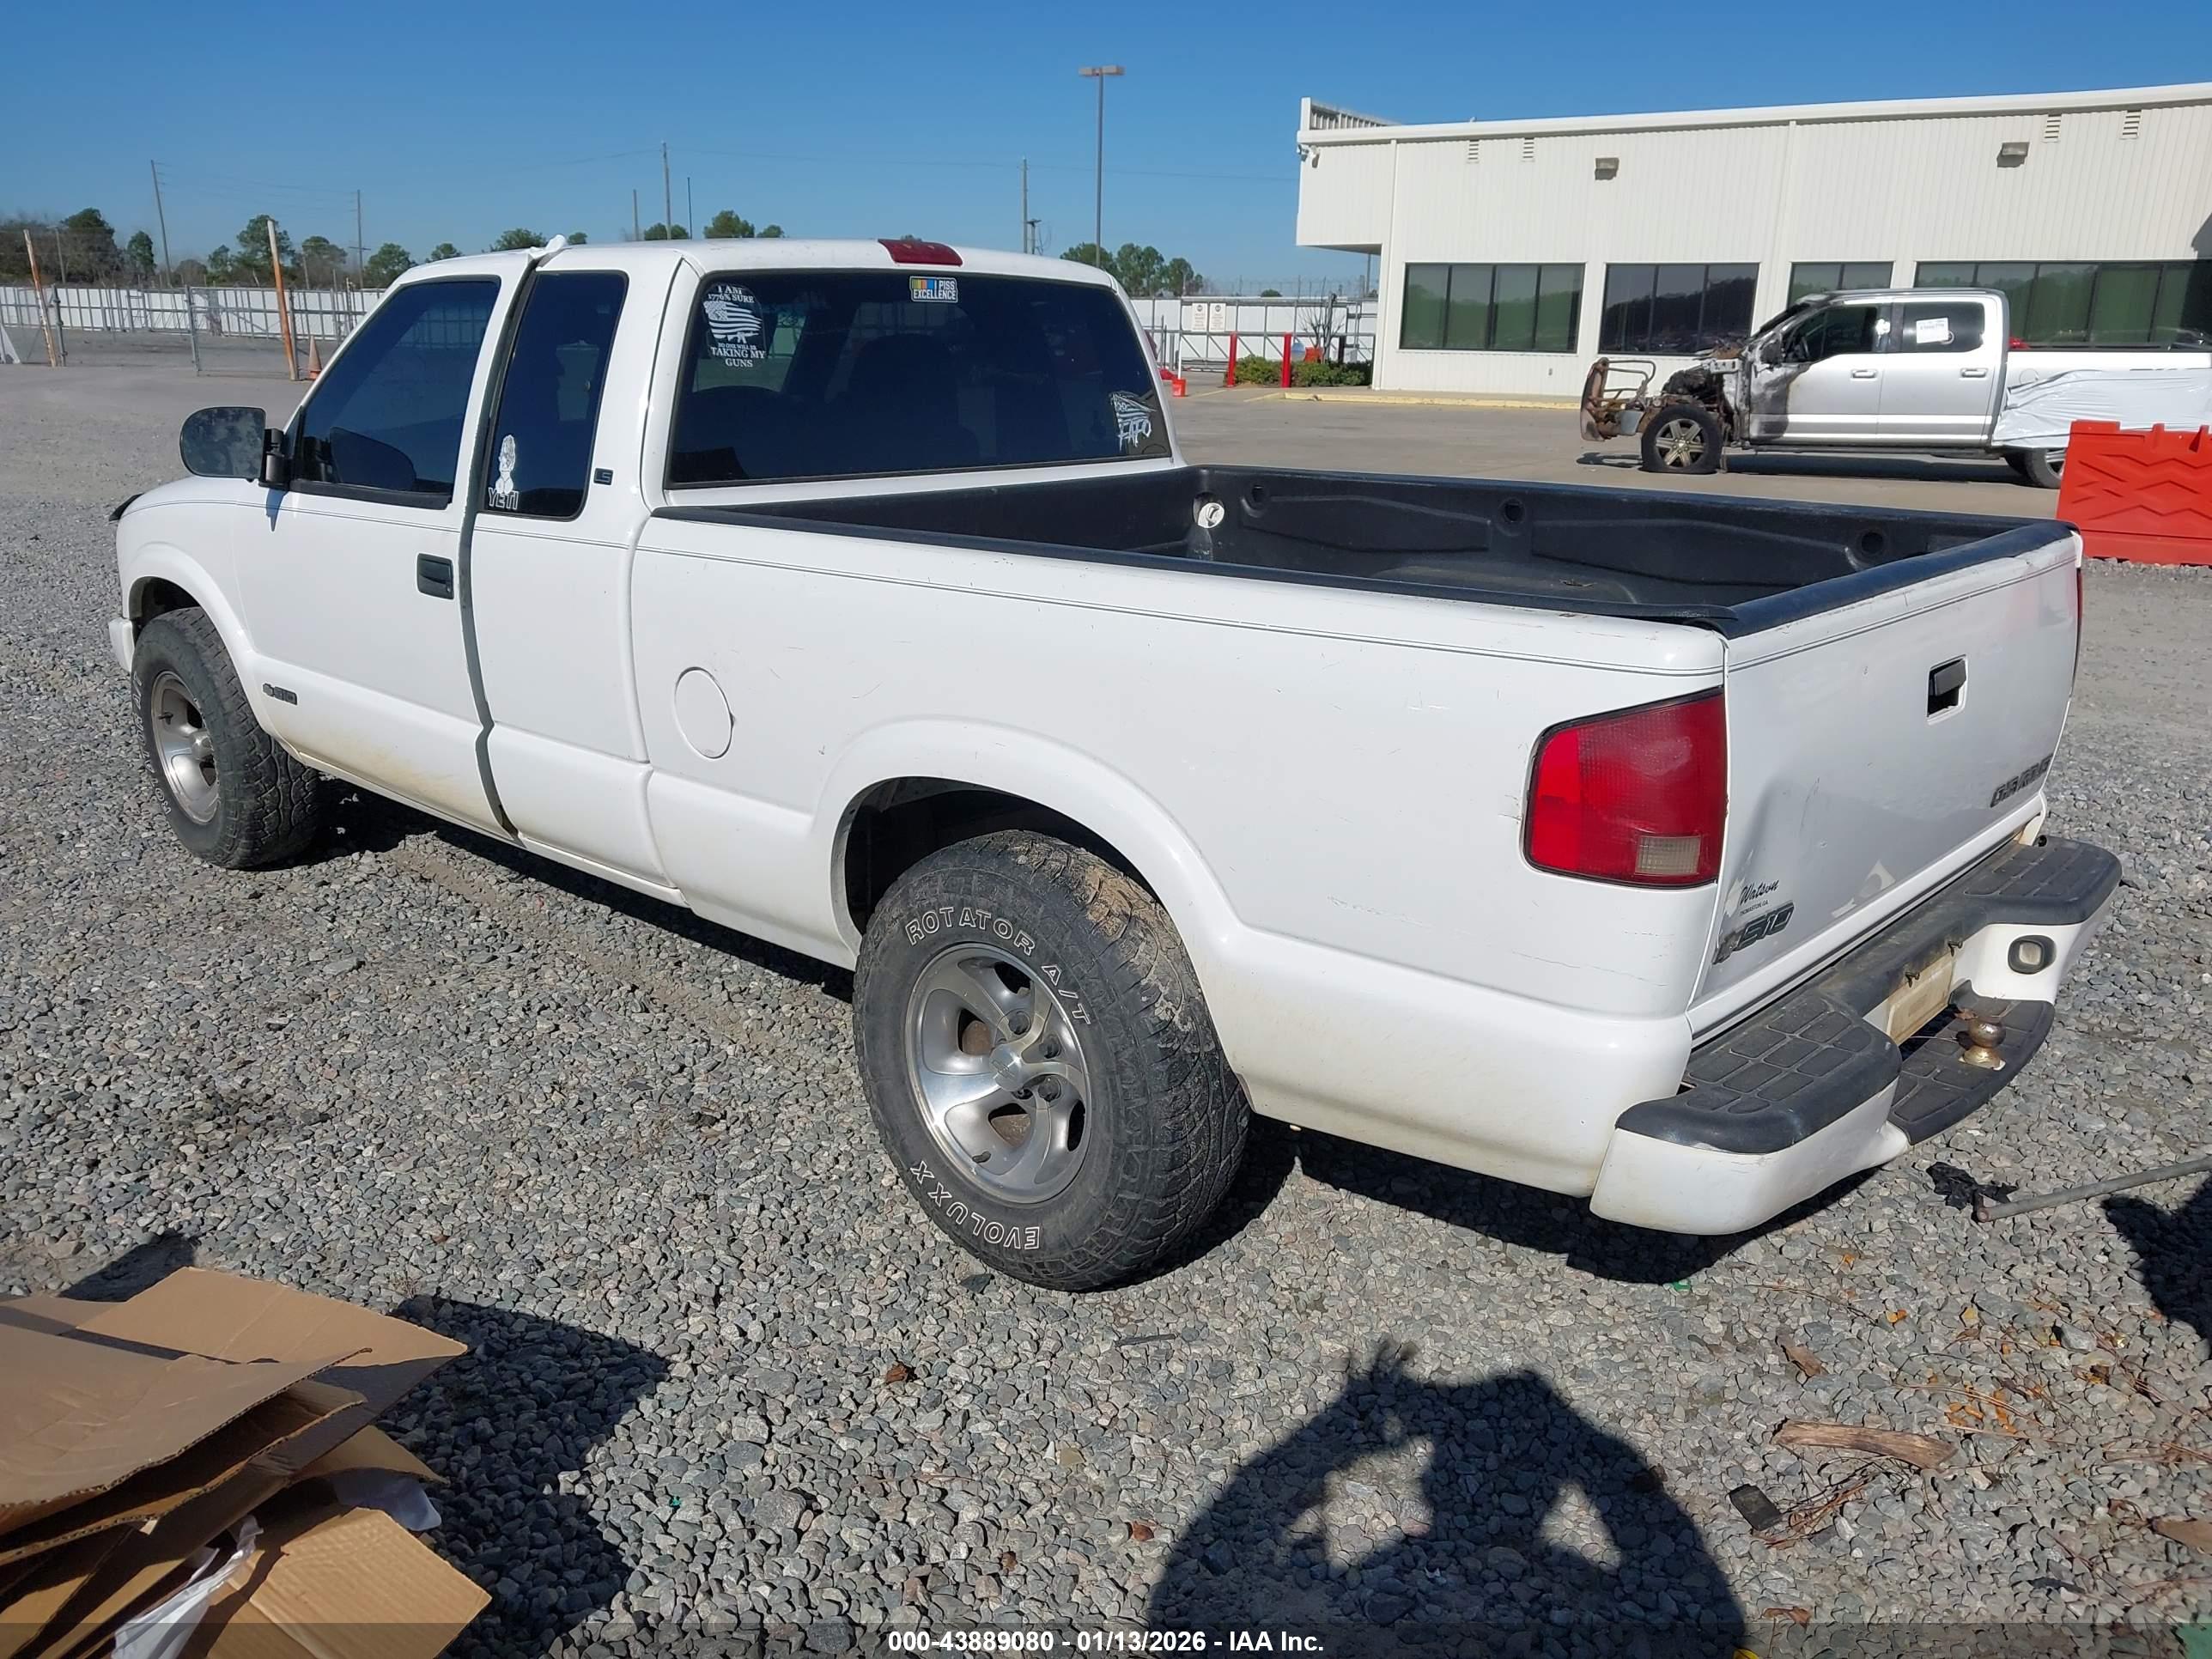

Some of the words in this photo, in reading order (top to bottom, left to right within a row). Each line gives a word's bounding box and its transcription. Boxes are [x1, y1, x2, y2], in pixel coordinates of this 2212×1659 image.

[725, 285, 743, 295] AM
[939, 280, 955, 290] PISS
[732, 295, 755, 303] SURE
[913, 289, 956, 300] EXCELLENCE
[710, 346, 749, 358] TAKING
[750, 350, 766, 359] MY
[725, 358, 753, 368] GUNS
[488, 487, 520, 510] YETI
[1740, 879, 1780, 906] Watson
[1732, 901, 1795, 952] S10
[905, 906, 1036, 956] ROTATOR
[1041, 964, 1091, 1024] A/T
[909, 1160, 1040, 1250] EVOLUXX
